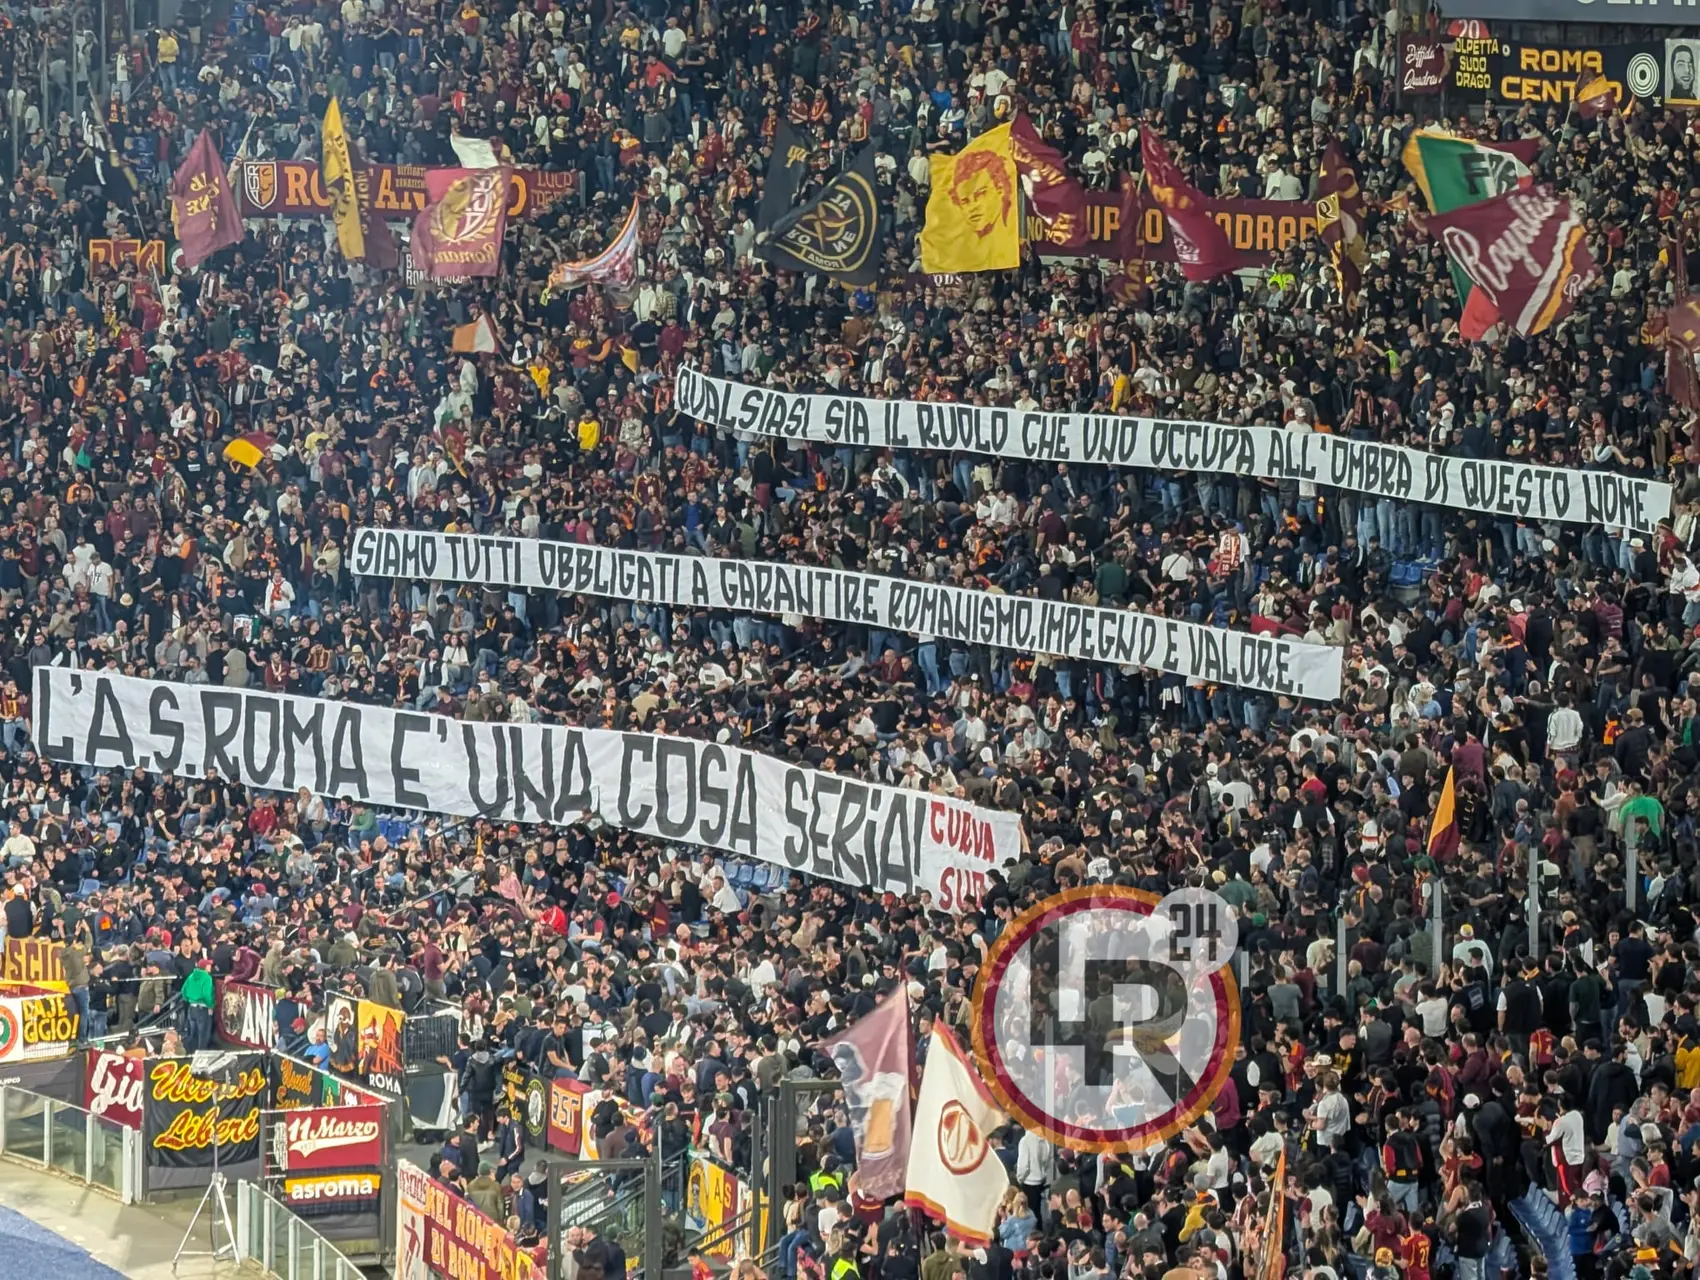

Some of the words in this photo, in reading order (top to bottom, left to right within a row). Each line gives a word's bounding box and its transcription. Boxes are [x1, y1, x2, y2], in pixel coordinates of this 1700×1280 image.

[1459, 19, 1480, 39] 20
[1520, 47, 1603, 73] ROMA
[1455, 72, 1491, 89] DRAGO
[678, 371, 811, 438] QUALSIASI
[825, 398, 870, 445] SIA
[885, 402, 908, 446] IL
[916, 403, 1009, 451] RUOLO
[1022, 413, 1071, 460] CHE
[1083, 416, 1138, 462] UNO
[1150, 421, 1255, 474] OCCUPA
[1424, 454, 1448, 503] DI
[1460, 460, 1570, 519] QUESTO
[356, 529, 437, 577] SIAMO
[445, 535, 521, 584] TUTTI
[538, 542, 680, 603] OBBLIGATI
[691, 559, 709, 604] A
[719, 560, 881, 624] GARANTIRE
[1162, 622, 1179, 671] E
[1188, 625, 1304, 695] VALORE.
[391, 712, 448, 809] E'
[462, 723, 597, 822] UNA
[617, 733, 758, 856] COSA
[930, 800, 995, 864] CURVA
[22, 994, 68, 1021] DAJE
[369, 1073, 402, 1096] ROMA
[153, 1107, 260, 1151] Liberi
[288, 1116, 312, 1142] 11
[310, 1115, 379, 1139] Marzo
[291, 1178, 373, 1200] asroma
